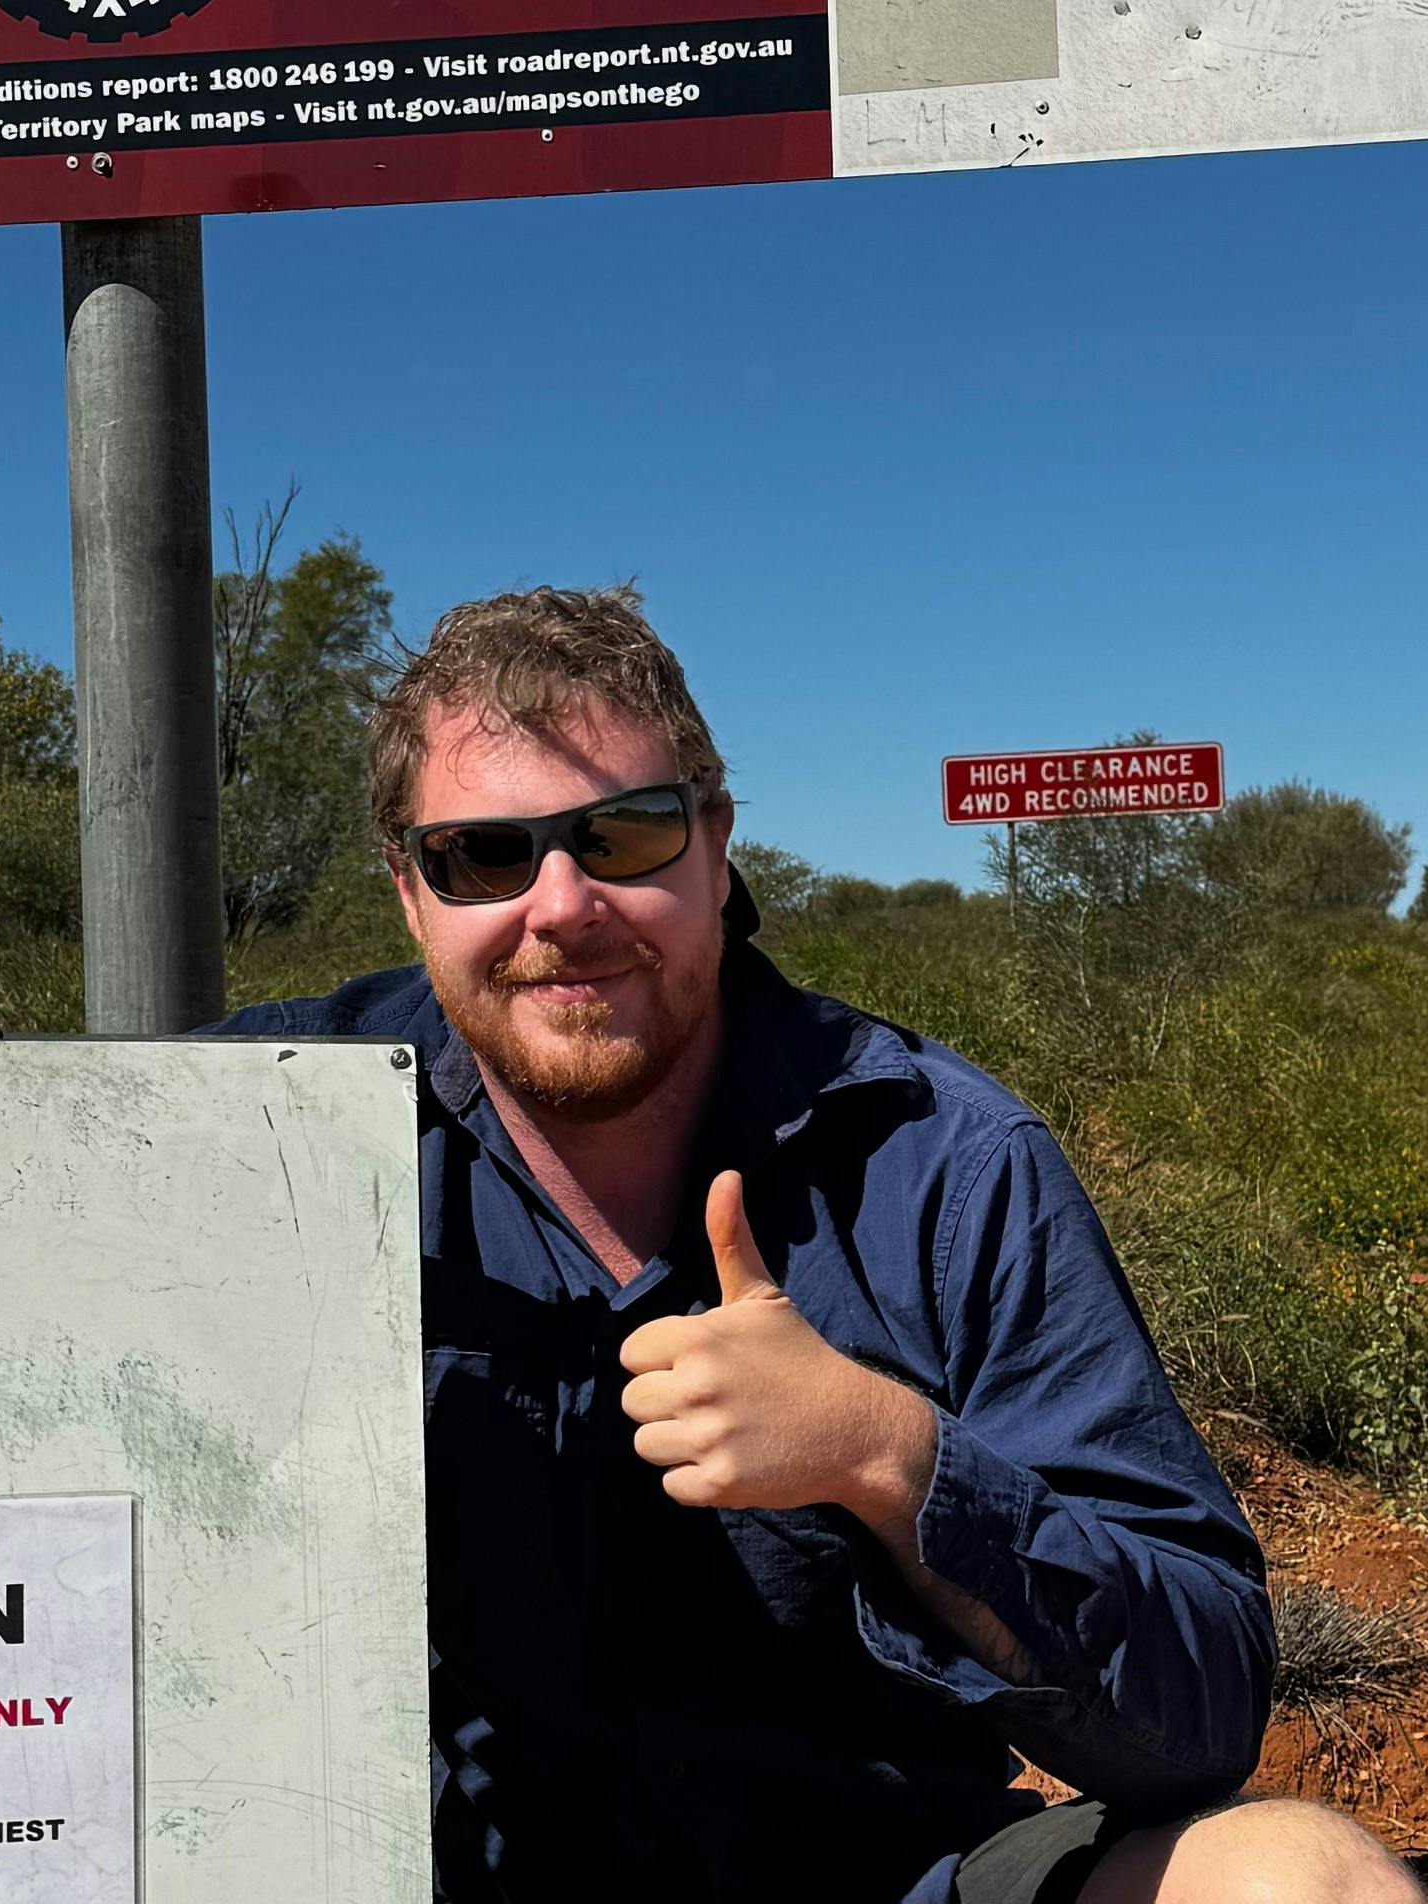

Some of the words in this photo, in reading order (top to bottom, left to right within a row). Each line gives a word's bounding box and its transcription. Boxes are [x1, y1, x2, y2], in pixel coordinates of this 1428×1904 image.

[103, 72, 197, 99] report:
[210, 66, 277, 90] 1800
[285, 63, 336, 85] 246
[344, 59, 394, 82] 199
[424, 54, 487, 77] Visit
[498, 40, 792, 73] roadreport.nt.gov.au
[971, 763, 1025, 785] HIGH
[1041, 754, 1193, 782] CLEARANCE
[959, 792, 1010, 814] 4WD
[1025, 782, 1208, 811] RECOMMENDED
